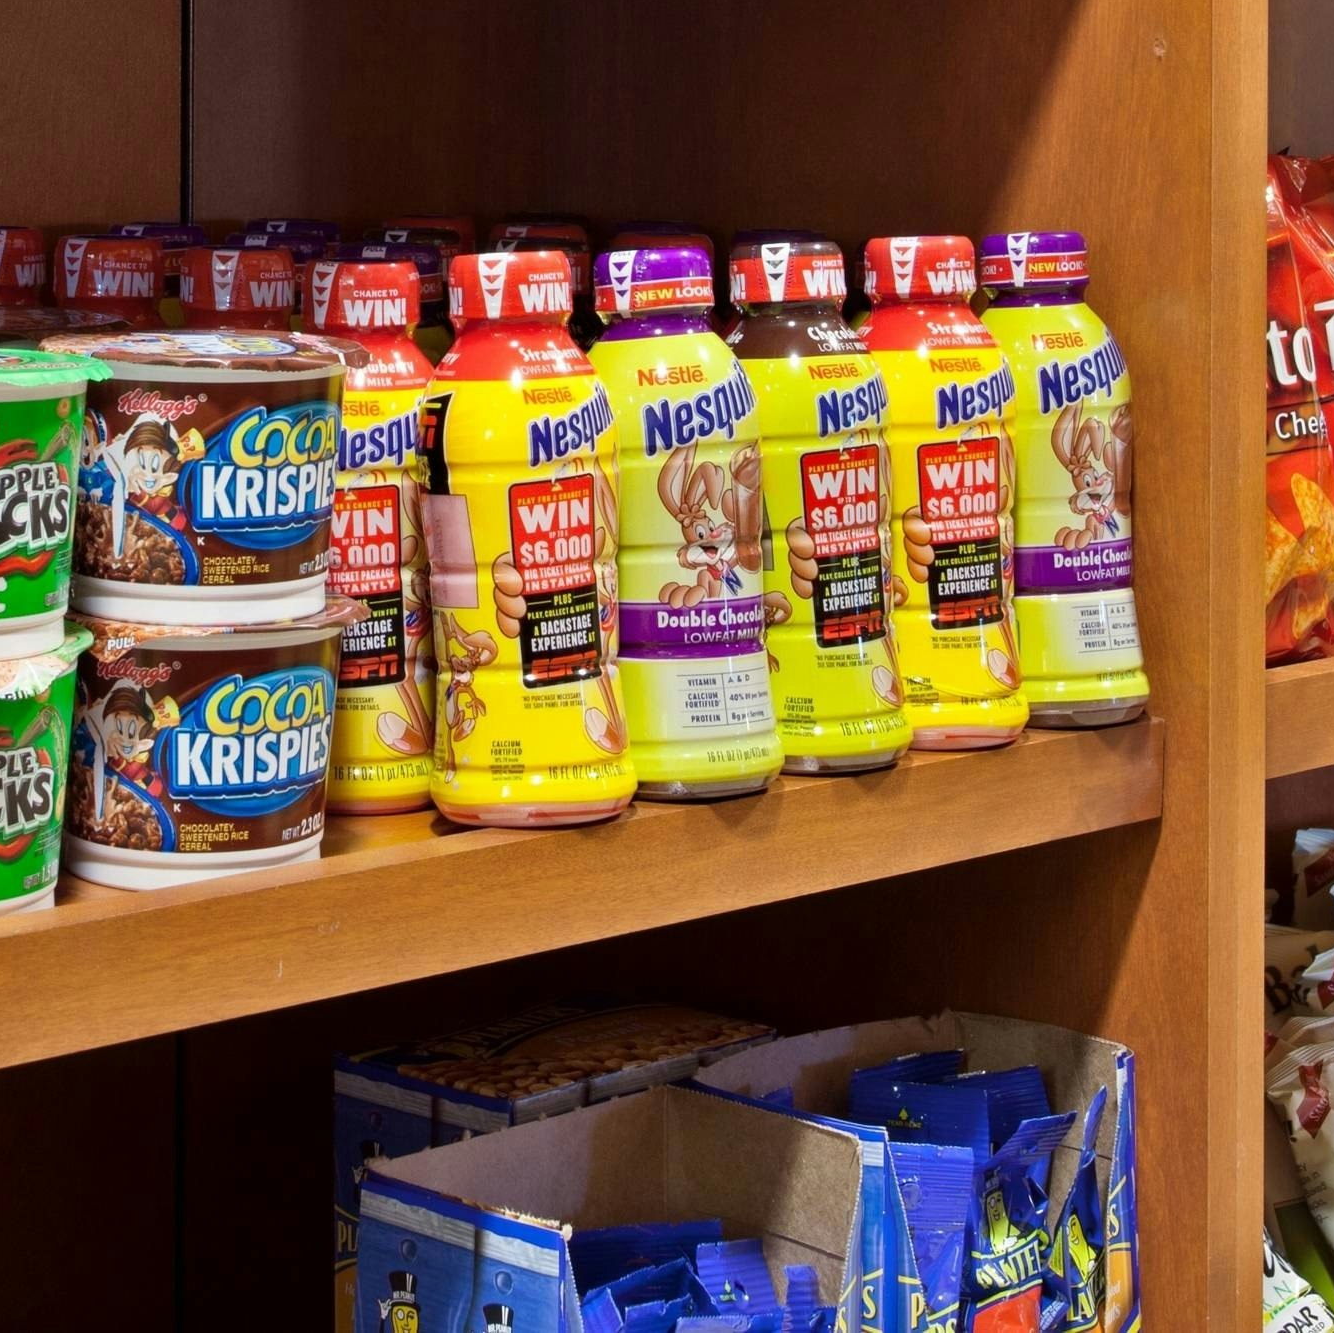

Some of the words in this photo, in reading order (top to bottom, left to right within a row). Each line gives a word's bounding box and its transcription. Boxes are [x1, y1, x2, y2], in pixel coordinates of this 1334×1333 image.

[1028, 261, 1056, 274] NEW
[635, 286, 675, 303] NEW
[342, 297, 408, 328] WIN!
[117, 387, 201, 422] Kellogg's
[229, 412, 339, 469] COCOA
[808, 465, 877, 500] WIN
[517, 496, 593, 540] WIN
[519, 533, 593, 568] $6,000
[202, 565, 252, 576] SWEETENED
[252, 563, 271, 574] RICE
[202, 574, 235, 585] CEREAL
[524, 572, 593, 594] INSTANTLY
[829, 579, 879, 597] BACKSTAGE
[552, 592, 574, 607] PLUS
[822, 594, 874, 613] EXPERIENCE
[540, 614, 593, 636] BACKSTAGE
[656, 605, 718, 630] Double
[530, 633, 588, 653] EXPERIENCE
[683, 629, 737, 645] LOWFAT
[736, 627, 761, 642] MILK
[687, 677, 718, 688] VITAMIN
[204, 679, 329, 737] COCOA
[690, 713, 722, 724] PROTEIN
[176, 714, 333, 788] KRISPIES
[490, 748, 524, 757] FORTIFIED
[491, 740, 522, 749] CALCIUM
